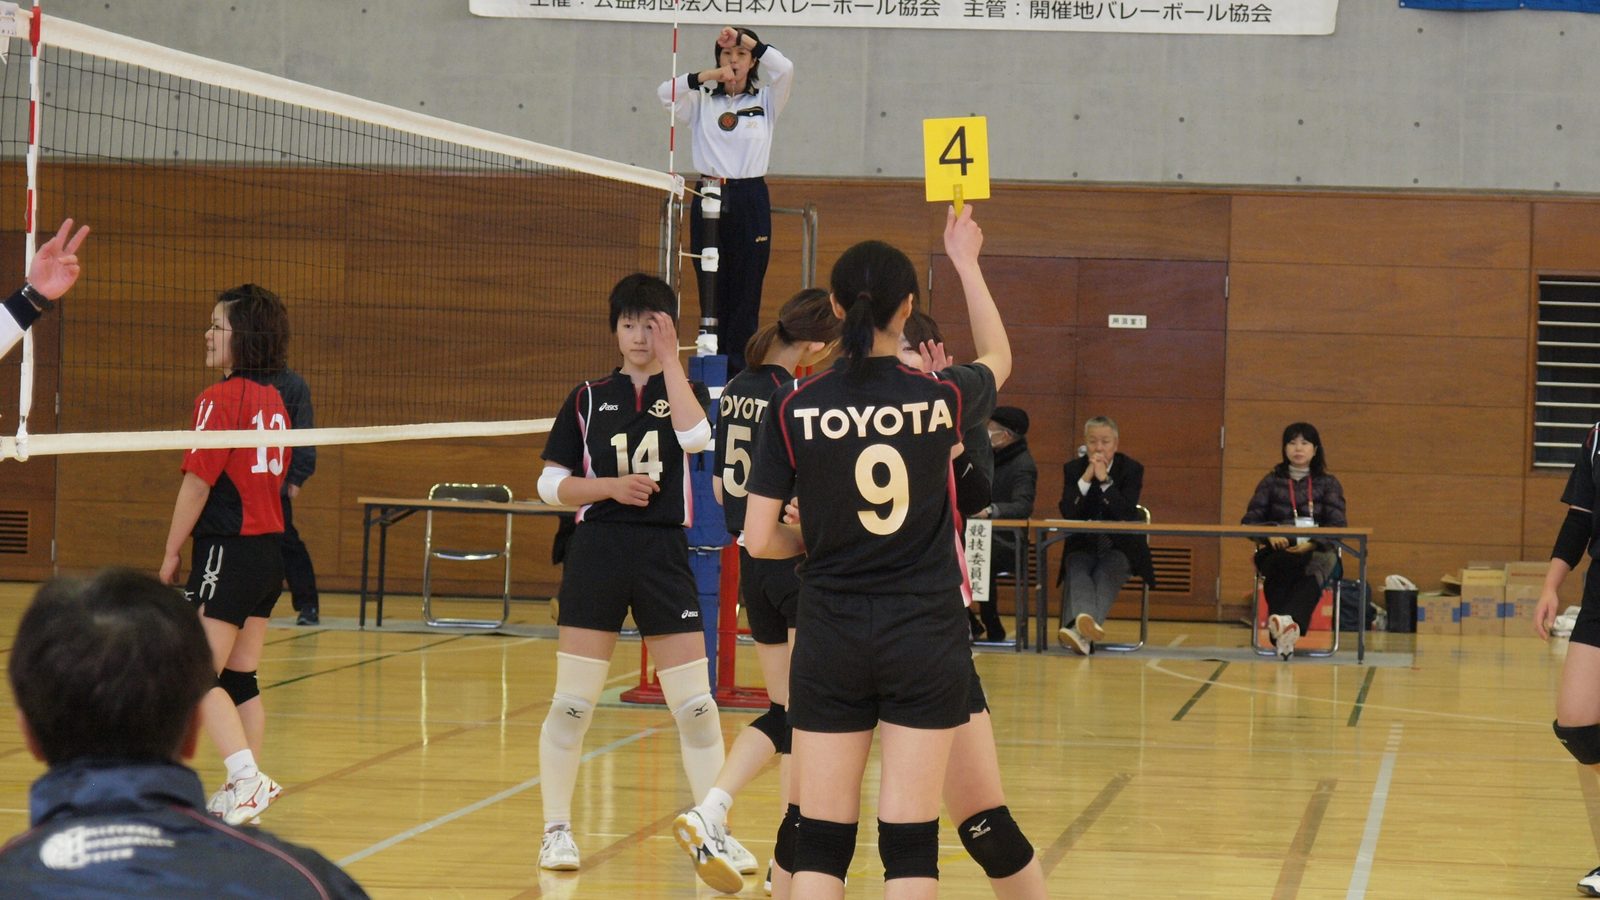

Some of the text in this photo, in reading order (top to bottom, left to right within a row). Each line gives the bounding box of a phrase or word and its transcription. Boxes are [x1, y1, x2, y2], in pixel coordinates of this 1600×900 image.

[939, 126, 974, 176] 4
[720, 395, 769, 424] OYOT
[794, 399, 953, 440] TOYOTA
[611, 430, 664, 481] 14
[722, 424, 752, 498] 5
[854, 443, 910, 536] 9
